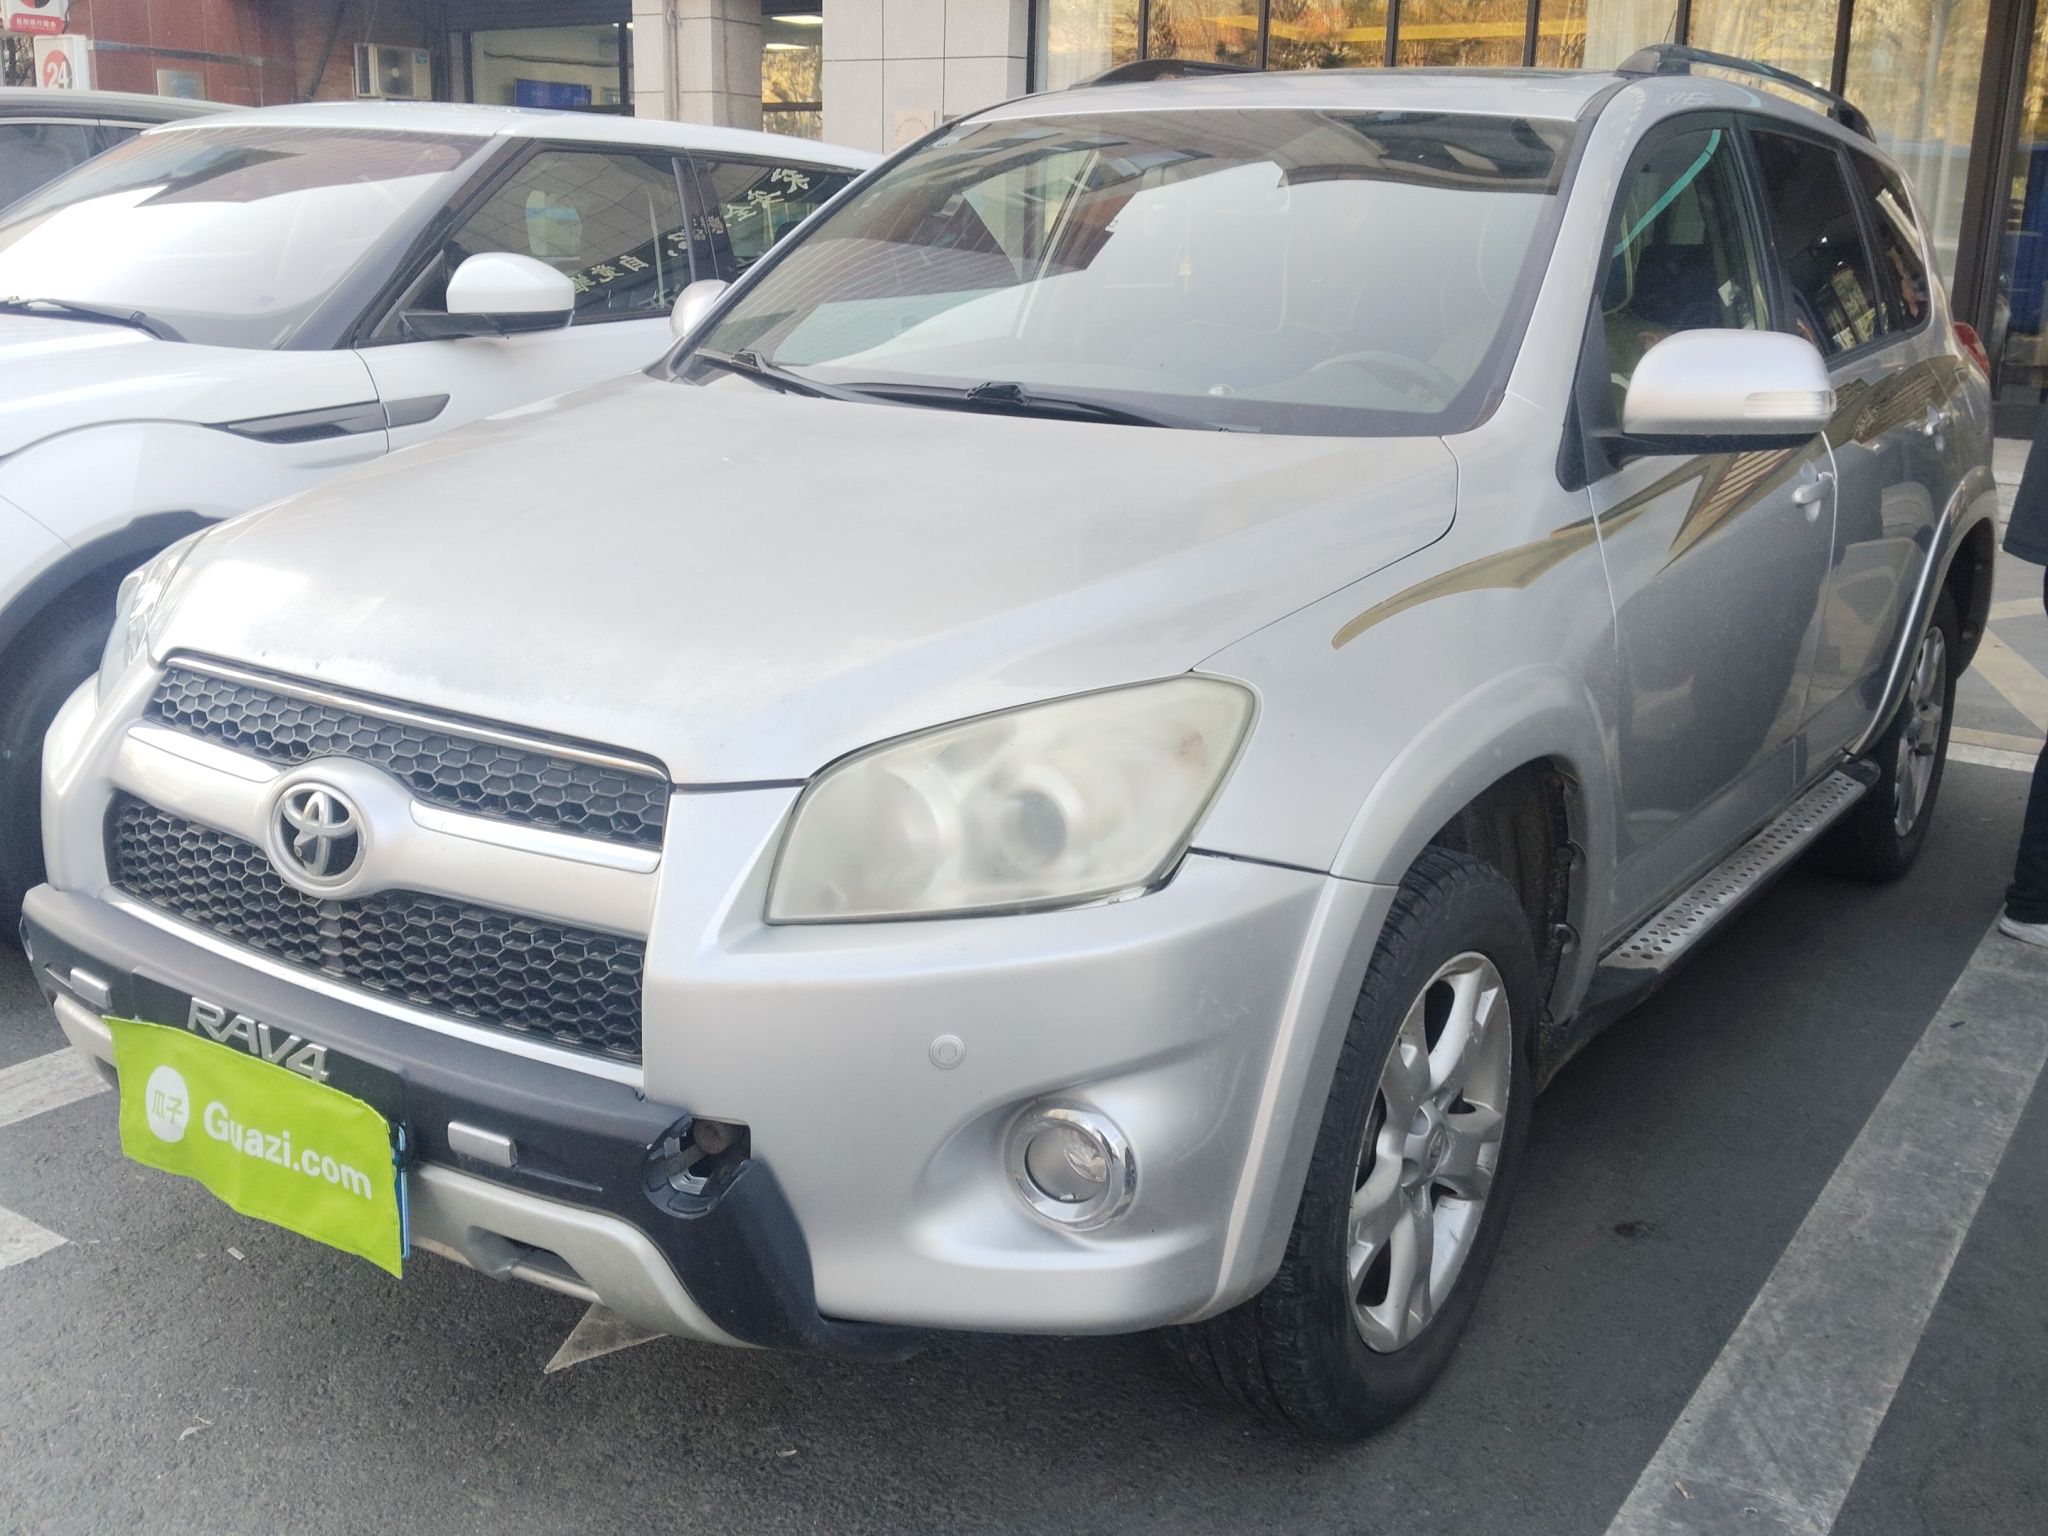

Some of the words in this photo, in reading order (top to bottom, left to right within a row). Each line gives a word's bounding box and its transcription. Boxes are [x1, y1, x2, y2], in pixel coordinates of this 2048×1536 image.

[47, 59, 69, 89] 24
[187, 996, 329, 1082] RAV4
[151, 1088, 185, 1125] 瓜子
[203, 1101, 373, 1200] Guazi.com
